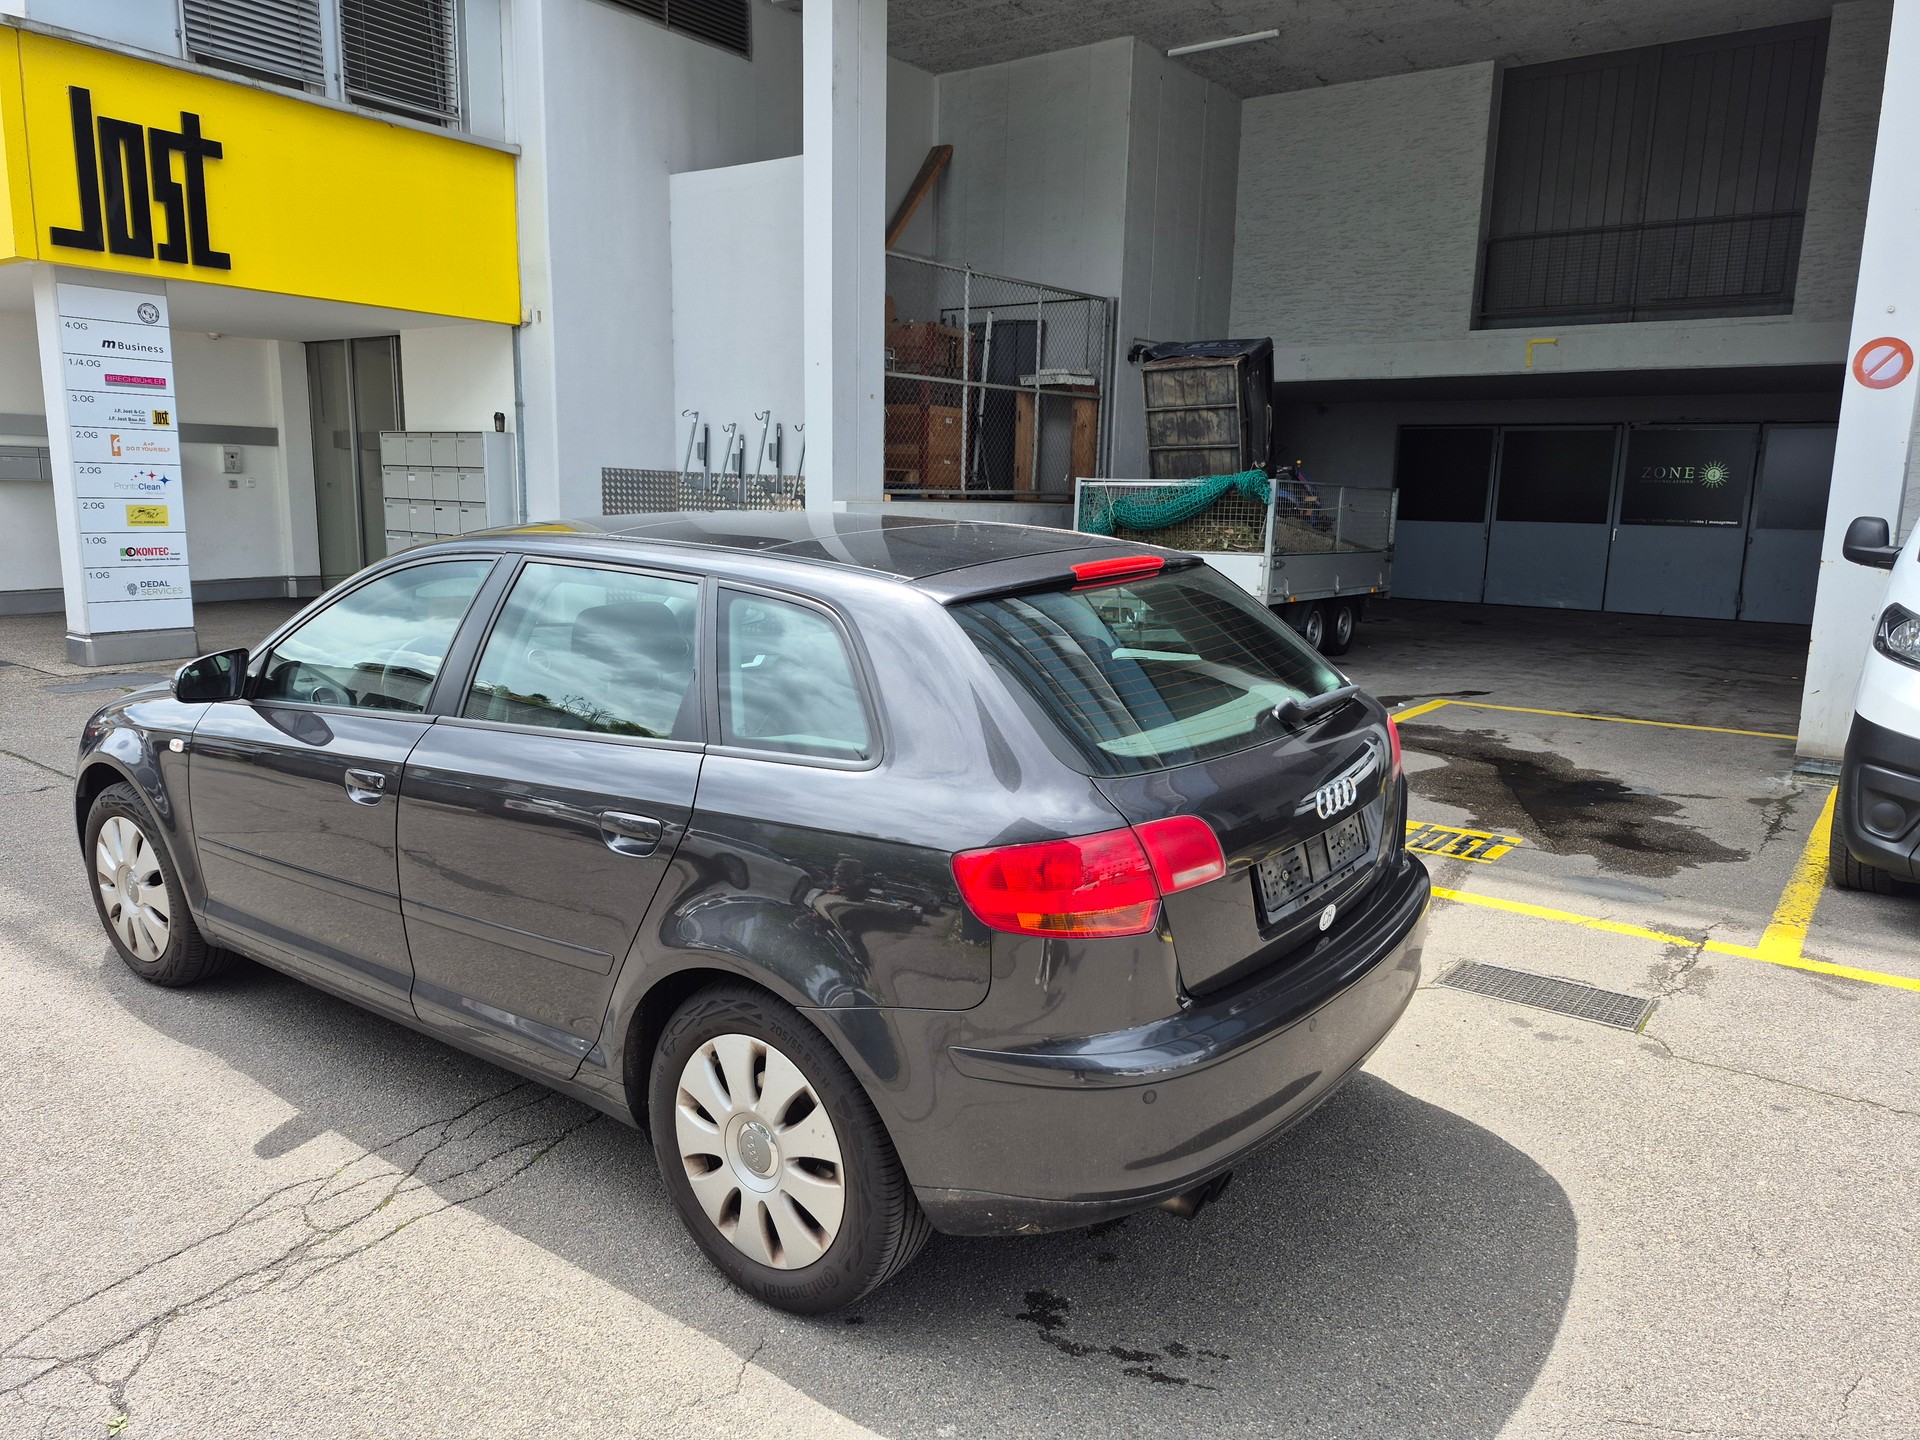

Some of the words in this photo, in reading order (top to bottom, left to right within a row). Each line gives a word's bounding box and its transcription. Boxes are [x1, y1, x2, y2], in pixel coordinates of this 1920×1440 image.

[65, 321, 88, 331] 4.OG
[68, 358, 101, 368] 1./4.OG
[72, 394, 95, 403] 3.OG
[75, 431, 98, 439] 2.OG
[79, 466, 102, 475] 2.OG
[1641, 466, 1695, 479] ZONE
[135, 546, 169, 556] KONTEC
[89, 571, 110, 579] 1.OG
[141, 587, 183, 596] SERVICES
